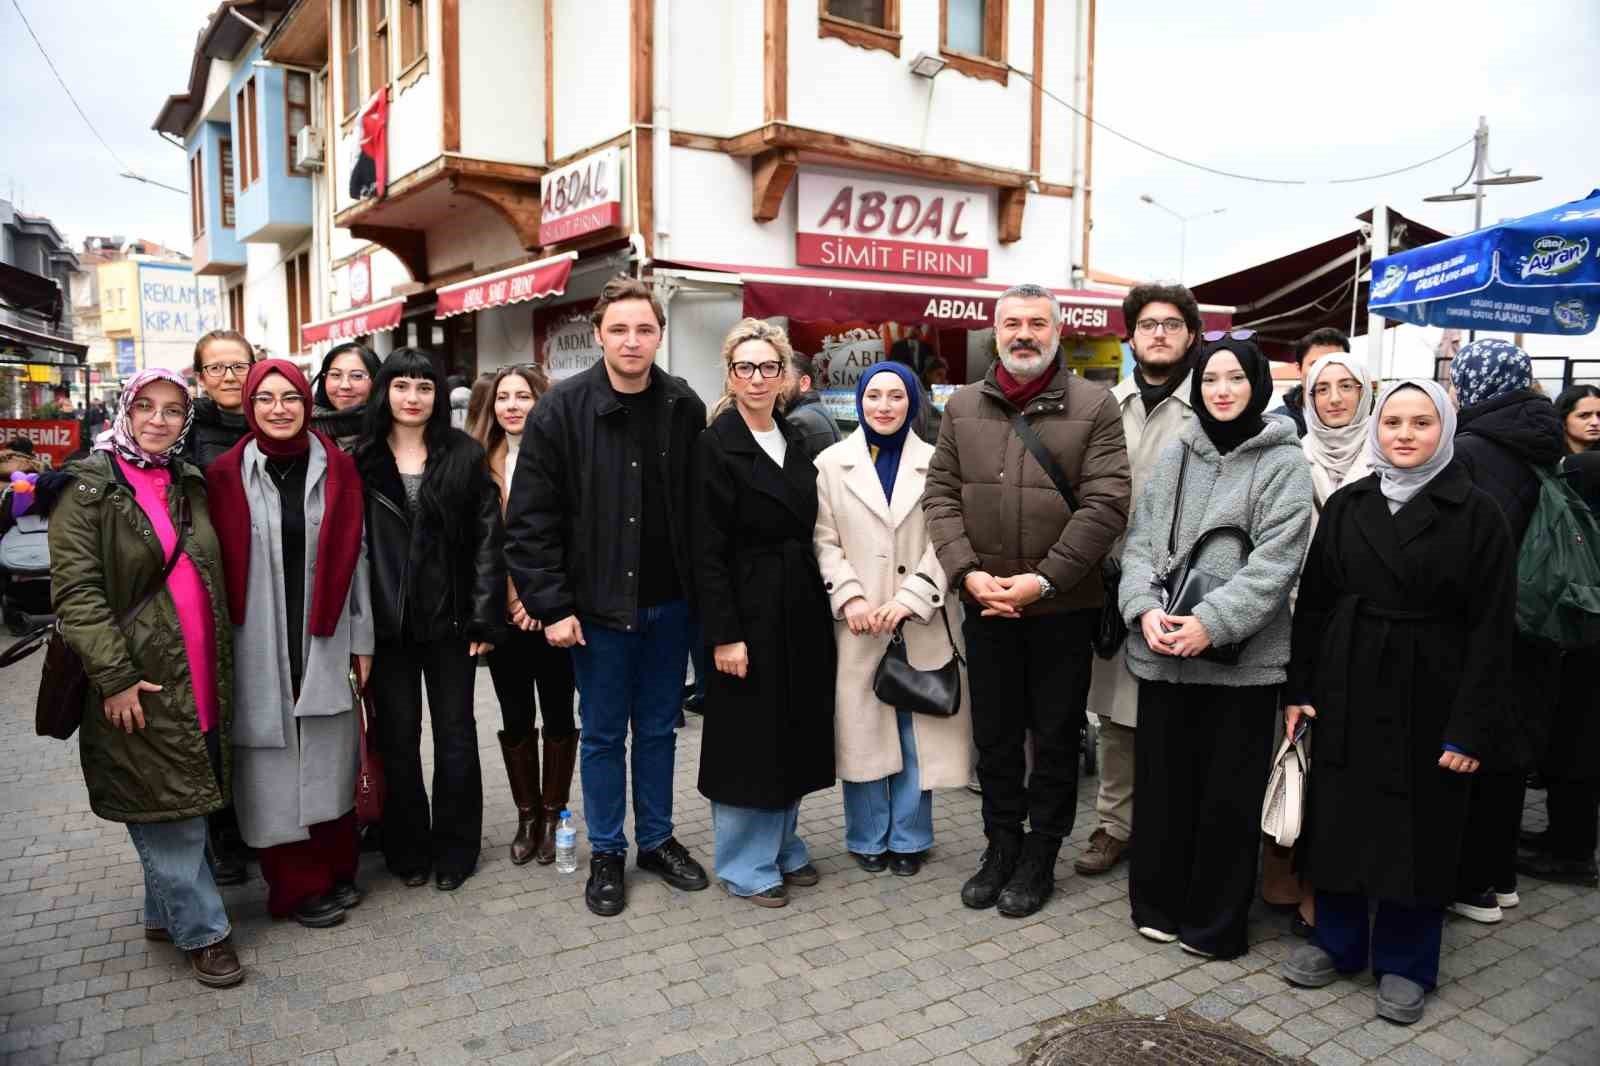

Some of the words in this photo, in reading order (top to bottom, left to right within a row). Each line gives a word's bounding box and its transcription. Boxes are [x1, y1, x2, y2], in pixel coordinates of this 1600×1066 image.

[541, 160, 609, 216] ABDAL
[818, 186, 969, 241] ABDAL
[821, 238, 893, 268] SİMİT
[902, 247, 973, 275] FIRINI
[1528, 245, 1581, 272] Ayran
[923, 298, 988, 321] ABDAL
[1060, 306, 1108, 328] HÇESI
[846, 350, 885, 368] ABD
